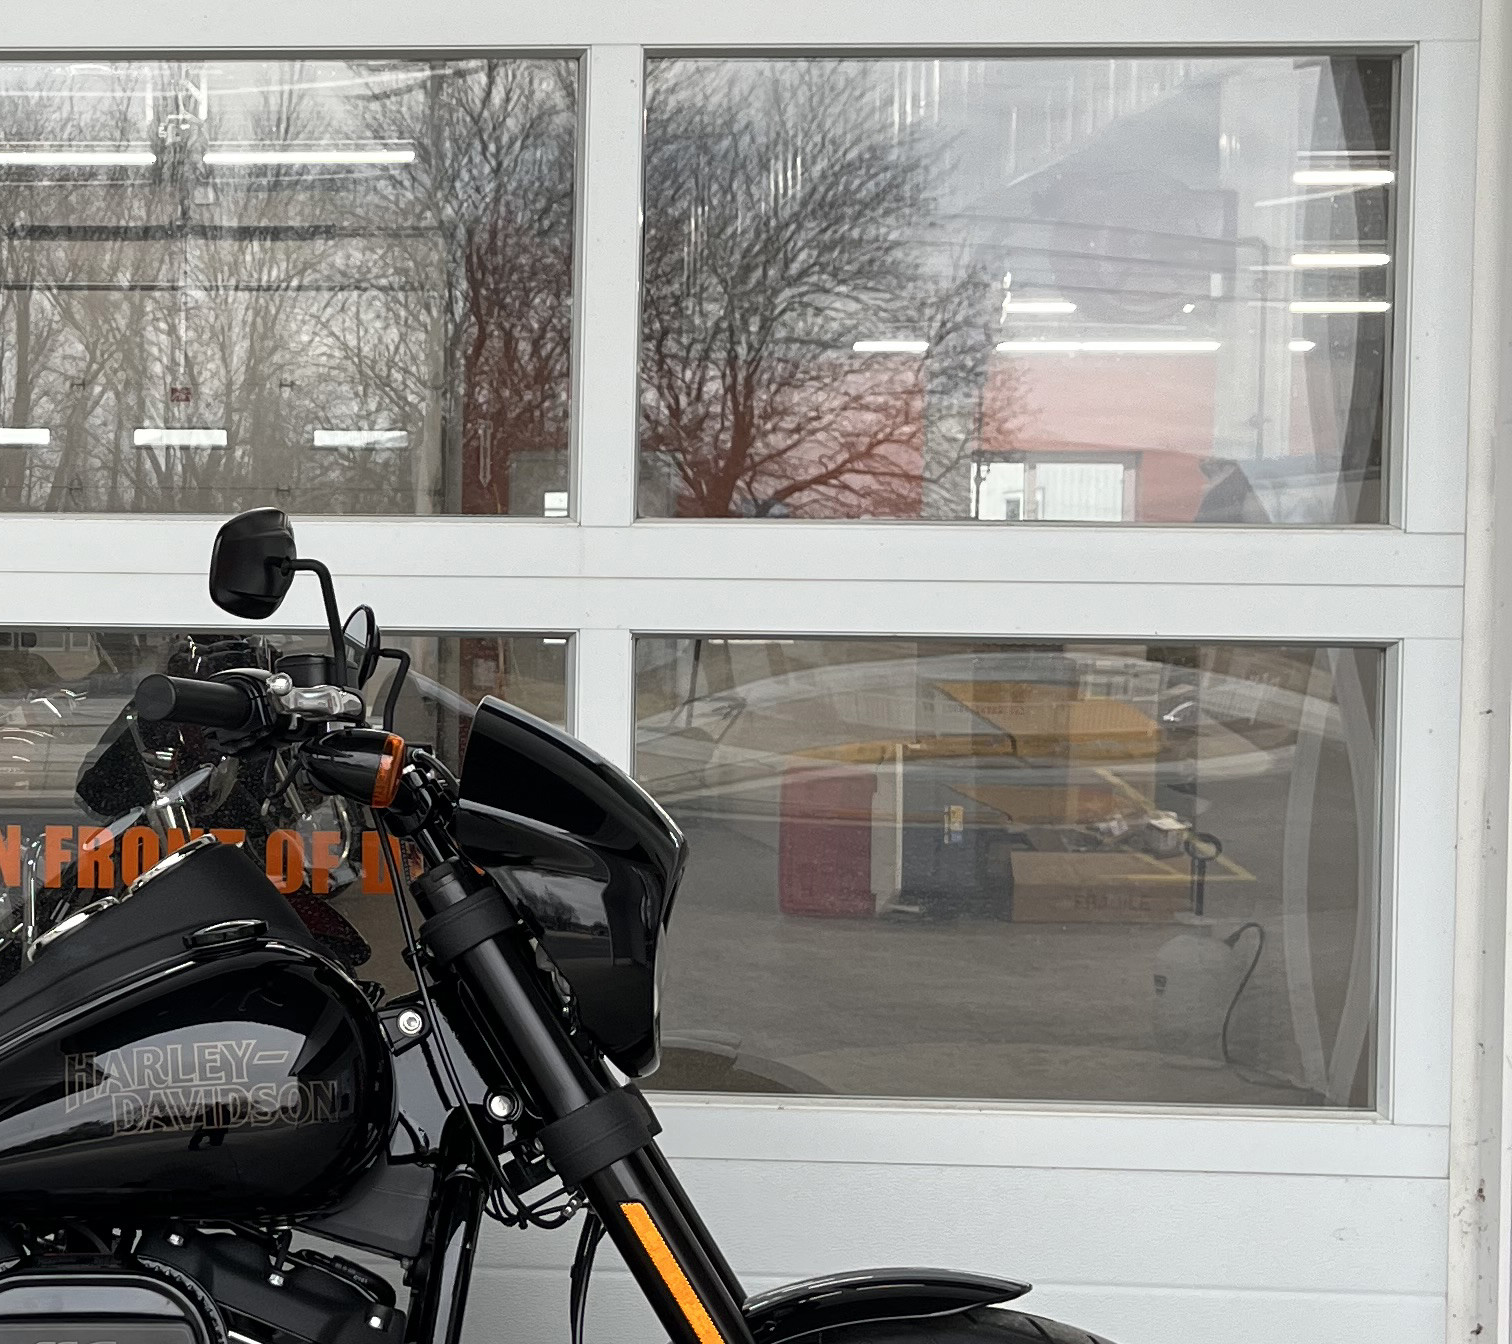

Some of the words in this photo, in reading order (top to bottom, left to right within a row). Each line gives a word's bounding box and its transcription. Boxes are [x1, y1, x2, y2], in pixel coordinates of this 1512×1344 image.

[44, 825, 246, 890] FRO
[265, 828, 342, 895] OF
[64, 1039, 289, 1114] HARLEY-
[111, 1080, 340, 1136] DAVIDSON
